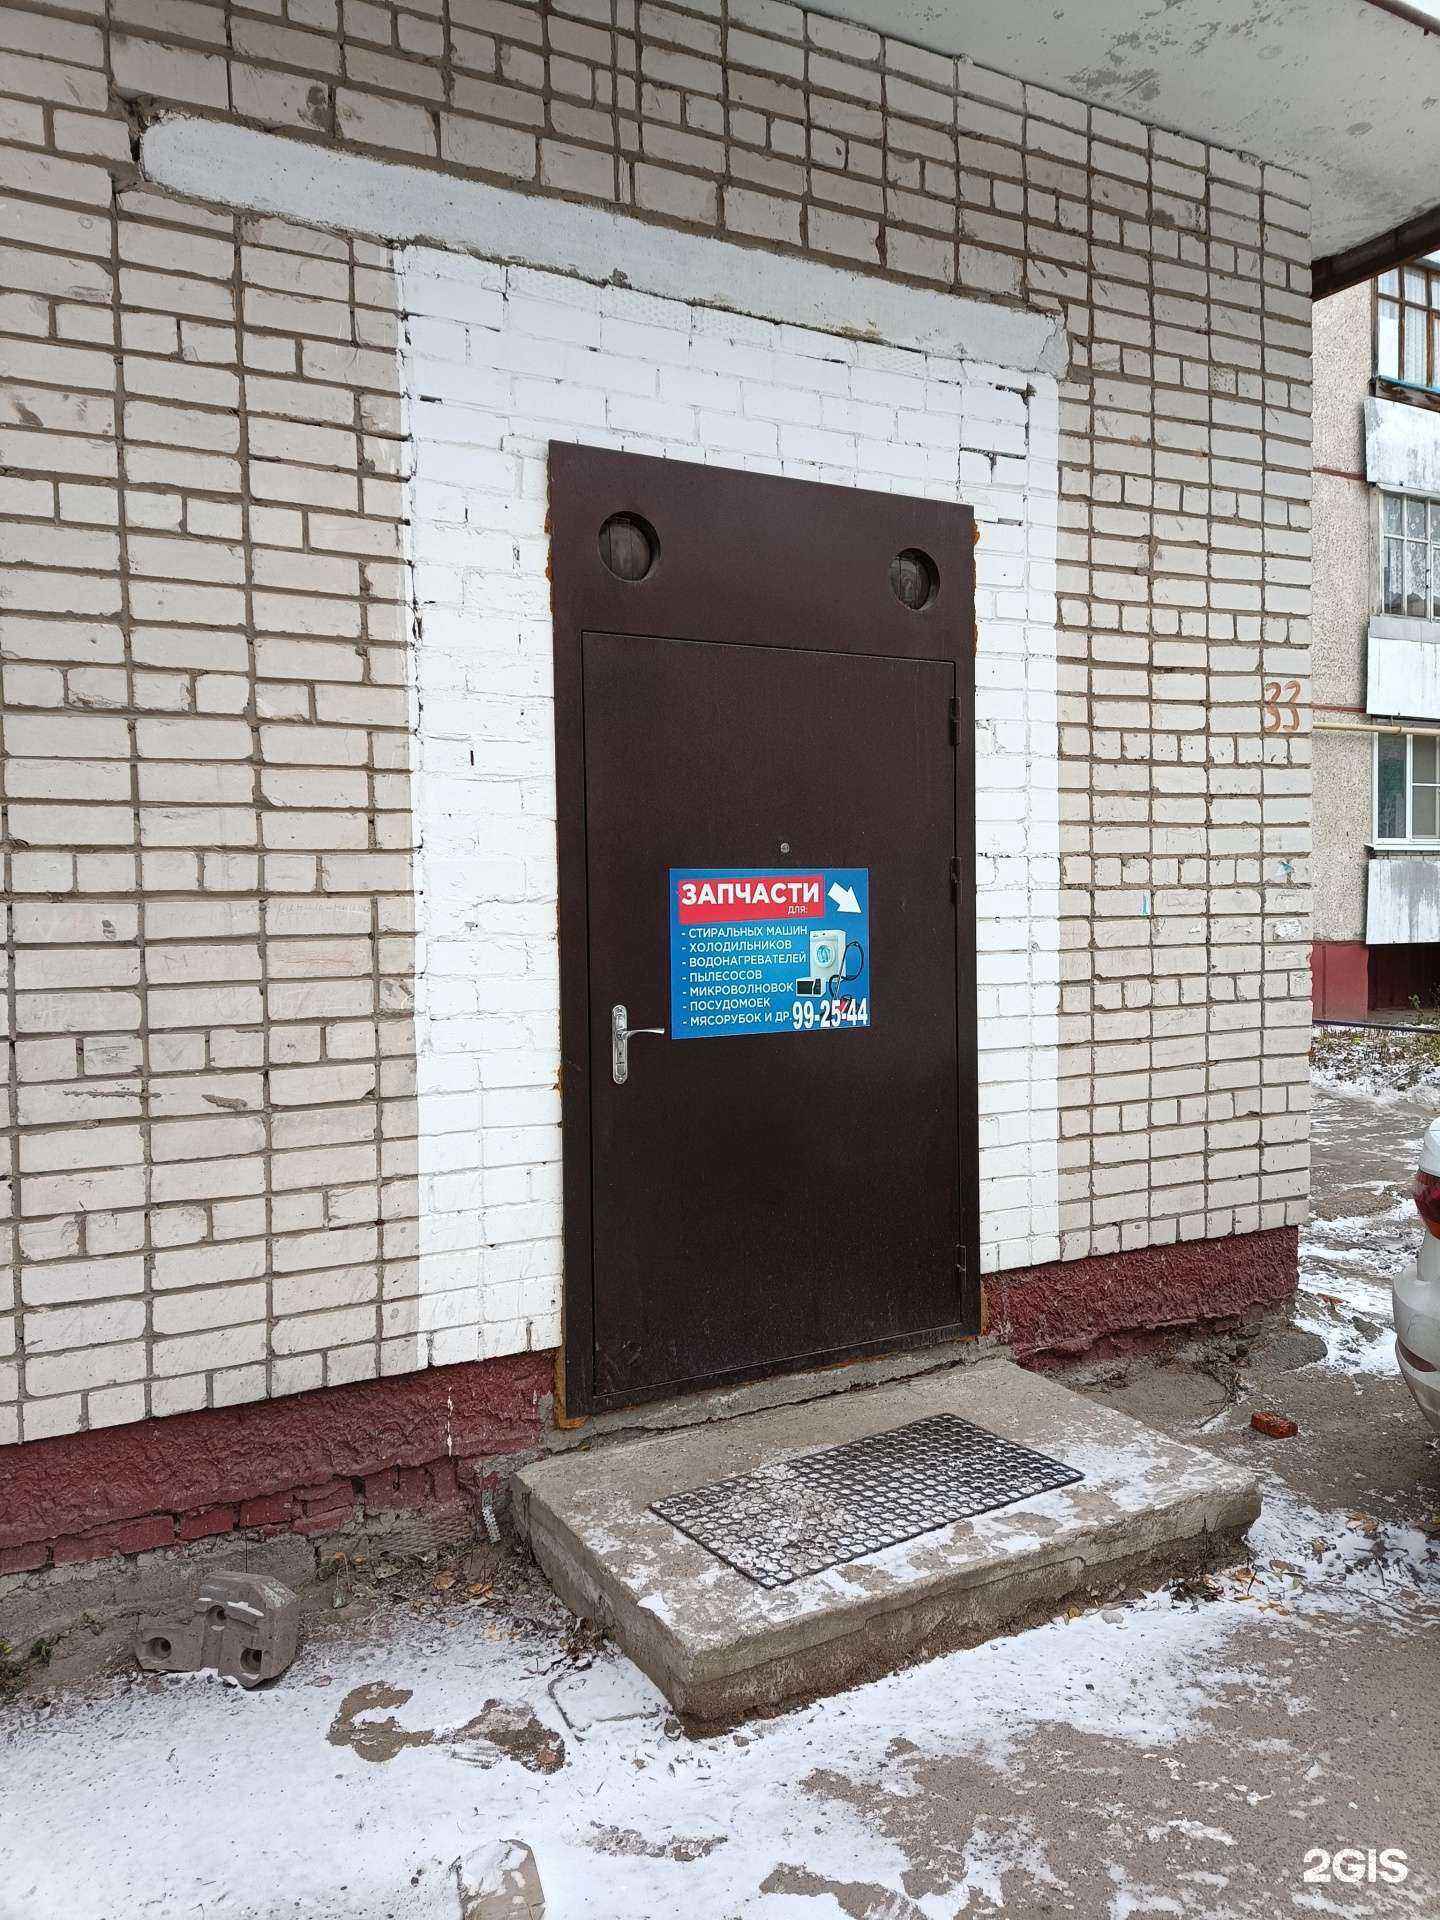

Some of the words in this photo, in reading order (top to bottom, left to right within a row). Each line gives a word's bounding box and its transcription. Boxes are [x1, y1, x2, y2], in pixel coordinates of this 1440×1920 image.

[1263, 680, 1301, 732] 33
[681, 883, 818, 905] ЗАПЧАСТИ
[689, 927, 763, 939] СТИРАЛЬНЫХ
[767, 926, 808, 936] МАШИН
[690, 940, 792, 953] ХОЛОДИЛЬНИКОВ
[690, 952, 807, 967] ВОДОНАГРЕВАТЕЛЕЙ
[690, 971, 762, 982] ПЫЛЕСОСОВ
[690, 982, 794, 996] МИКРОВОЛНОВОК
[690, 998, 771, 1012] ПОСУДОМОЕК
[690, 1013, 761, 1026] МЯСОРУБОК
[765, 1013, 772, 1022] И
[792, 998, 868, 1029] 99-25-44
